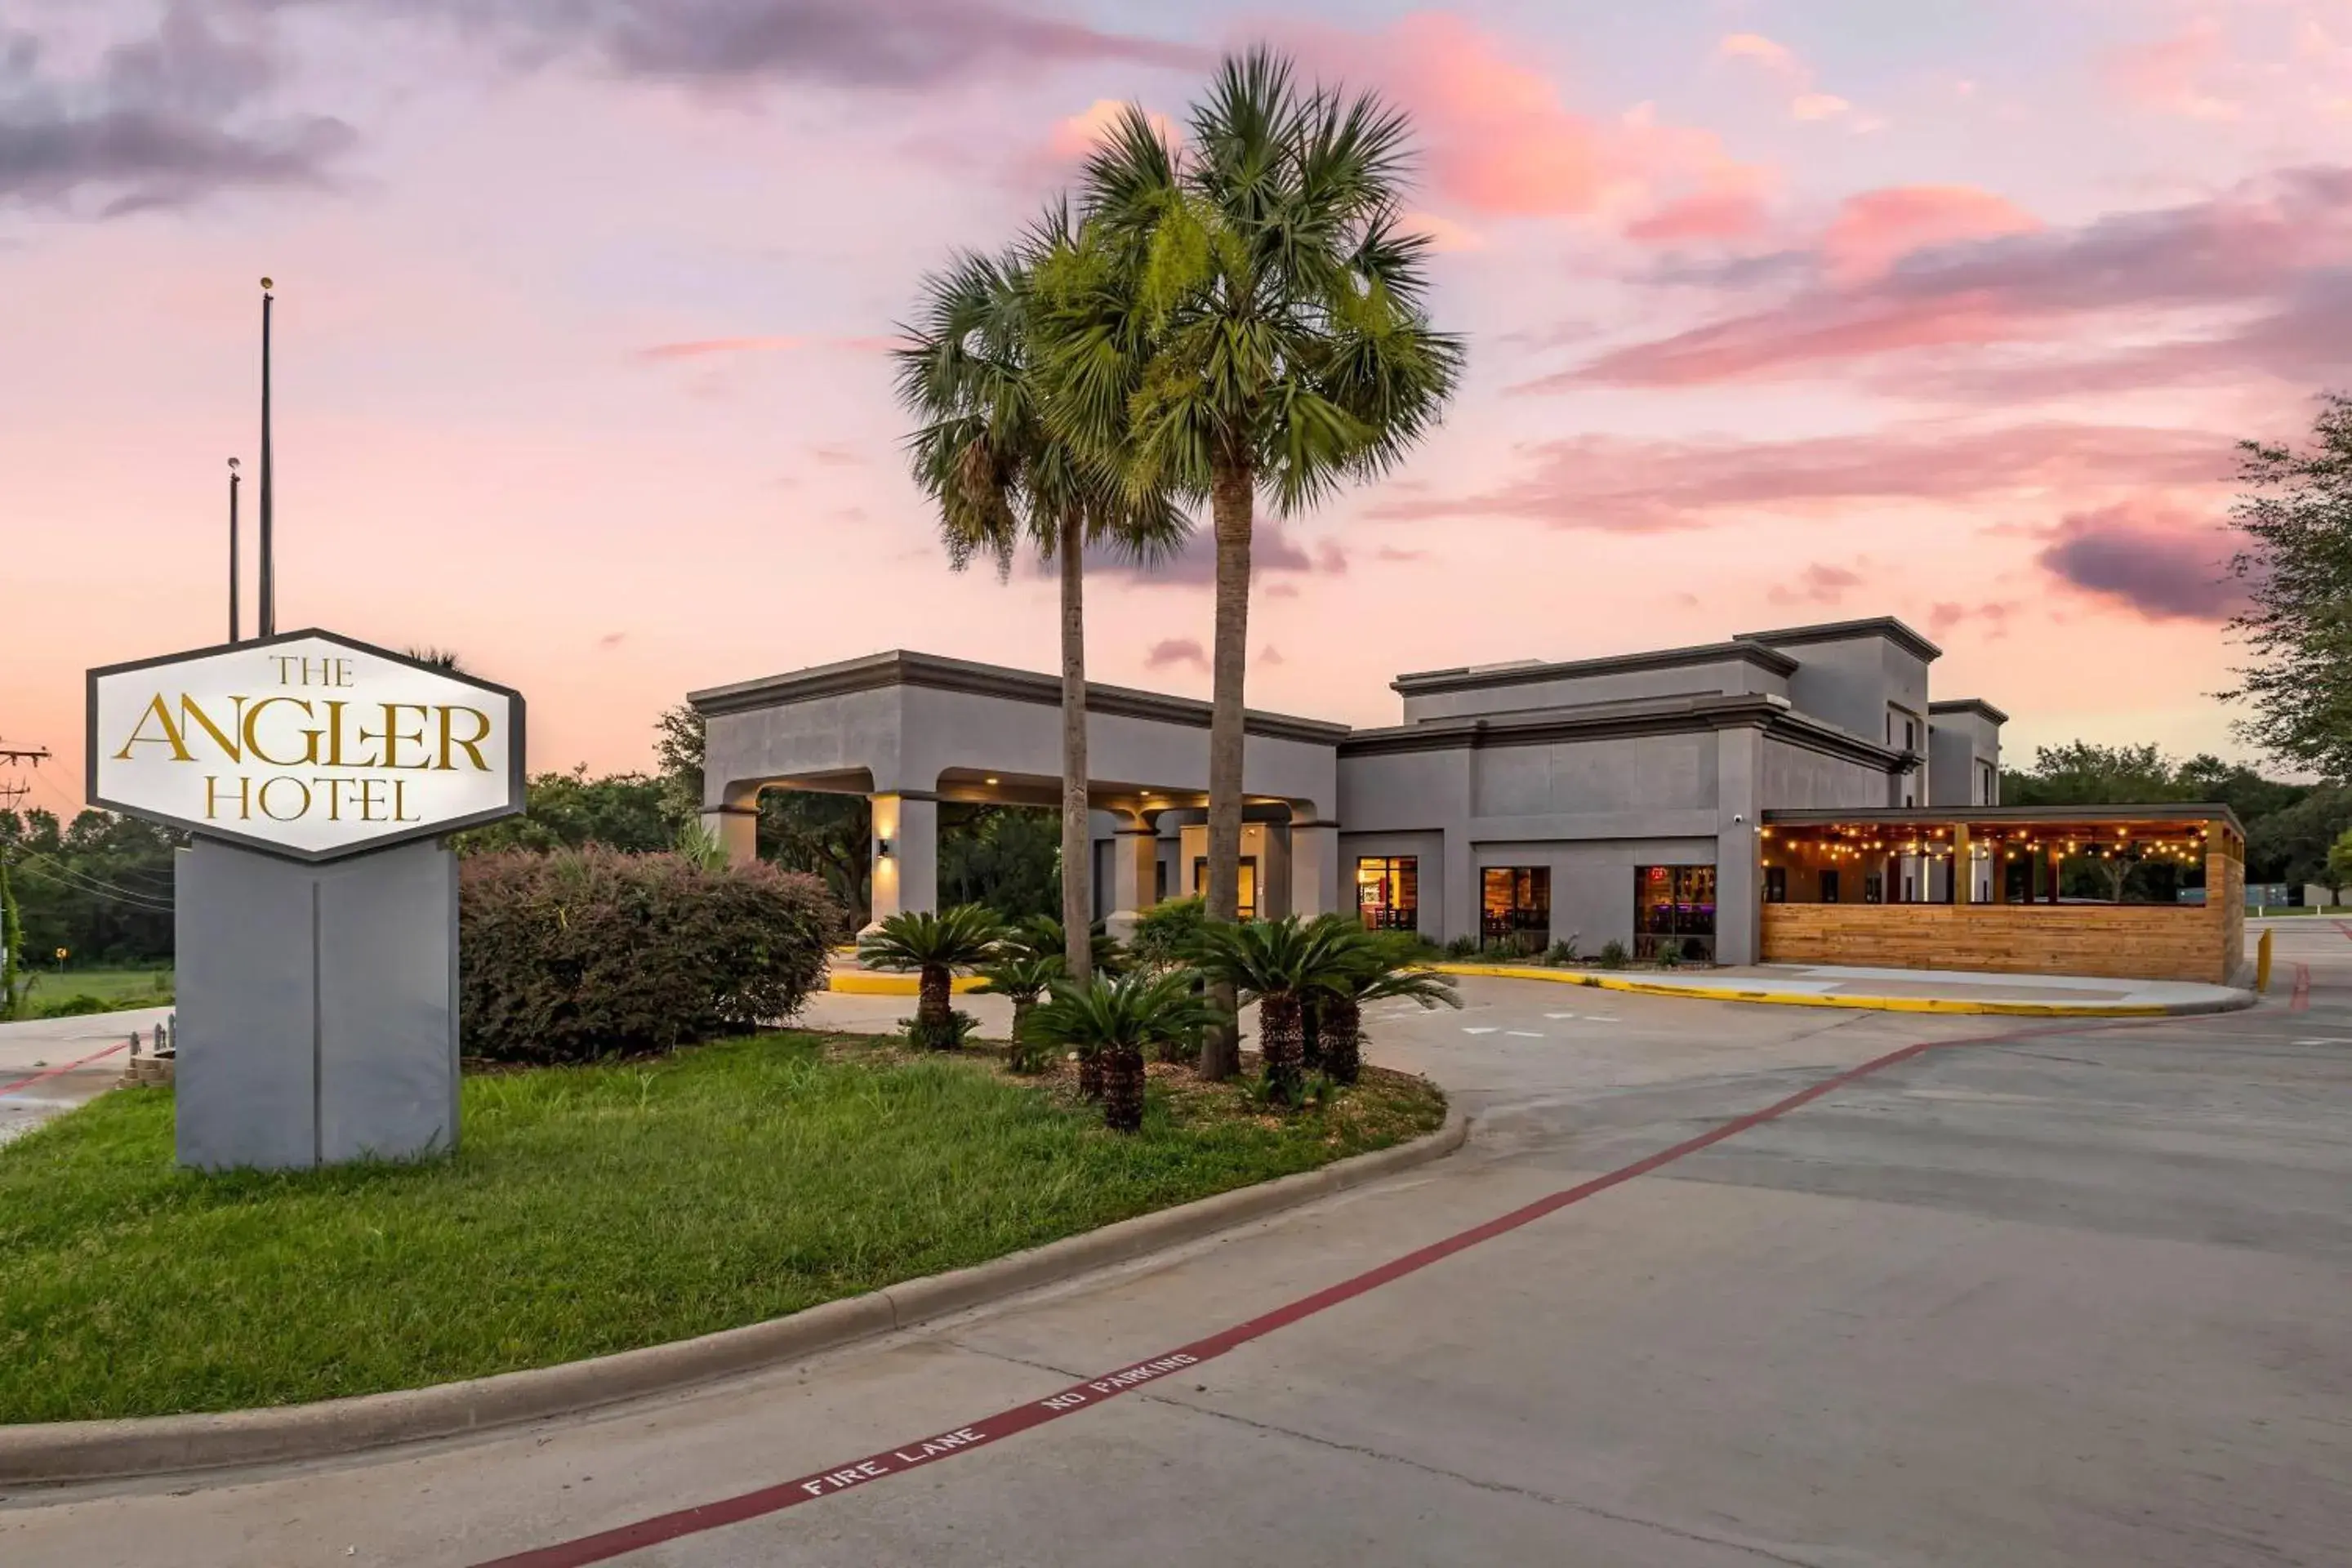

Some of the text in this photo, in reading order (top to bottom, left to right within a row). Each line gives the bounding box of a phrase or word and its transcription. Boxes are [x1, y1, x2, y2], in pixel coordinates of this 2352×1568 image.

[270, 656, 354, 687] THE
[111, 693, 492, 771] ANGLER
[203, 776, 421, 821] HOTEL
[801, 1353, 1198, 1496] FIRE LANE NO PARKING
